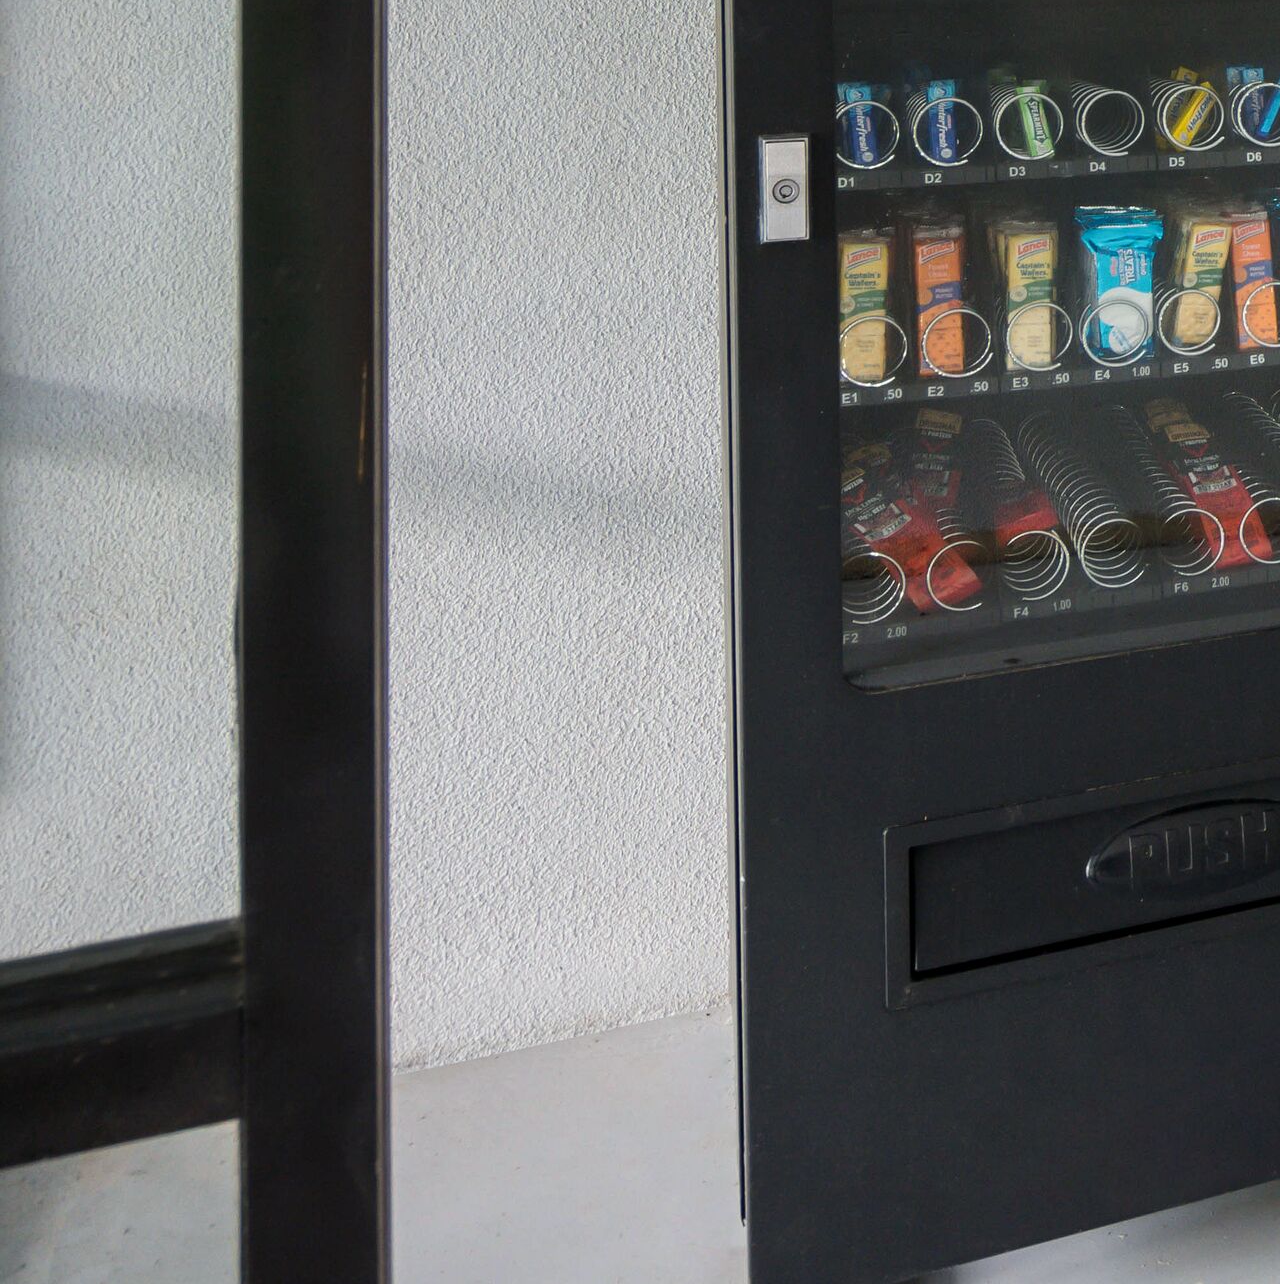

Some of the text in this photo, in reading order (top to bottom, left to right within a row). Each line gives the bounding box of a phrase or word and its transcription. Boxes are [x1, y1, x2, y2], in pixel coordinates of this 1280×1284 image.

[1169, 157, 1185, 167] D5
[1247, 152, 1262, 162] D6
[1009, 167, 1026, 177] D3
[1090, 162, 1106, 172] D4
[838, 177, 855, 188] D1
[925, 173, 942, 184] D2
[1174, 358, 1229, 374] E5 .50
[1250, 354, 1265, 365] E6
[1013, 373, 1070, 388] E3 .50
[1095, 366, 1151, 381] E4 1.00
[928, 381, 989, 396] E2 .50
[842, 389, 903, 403] E1 .50
[1174, 576, 1230, 594] F6 2.00
[1014, 599, 1072, 618] F4 1.00
[843, 626, 908, 644] F2 2.00
